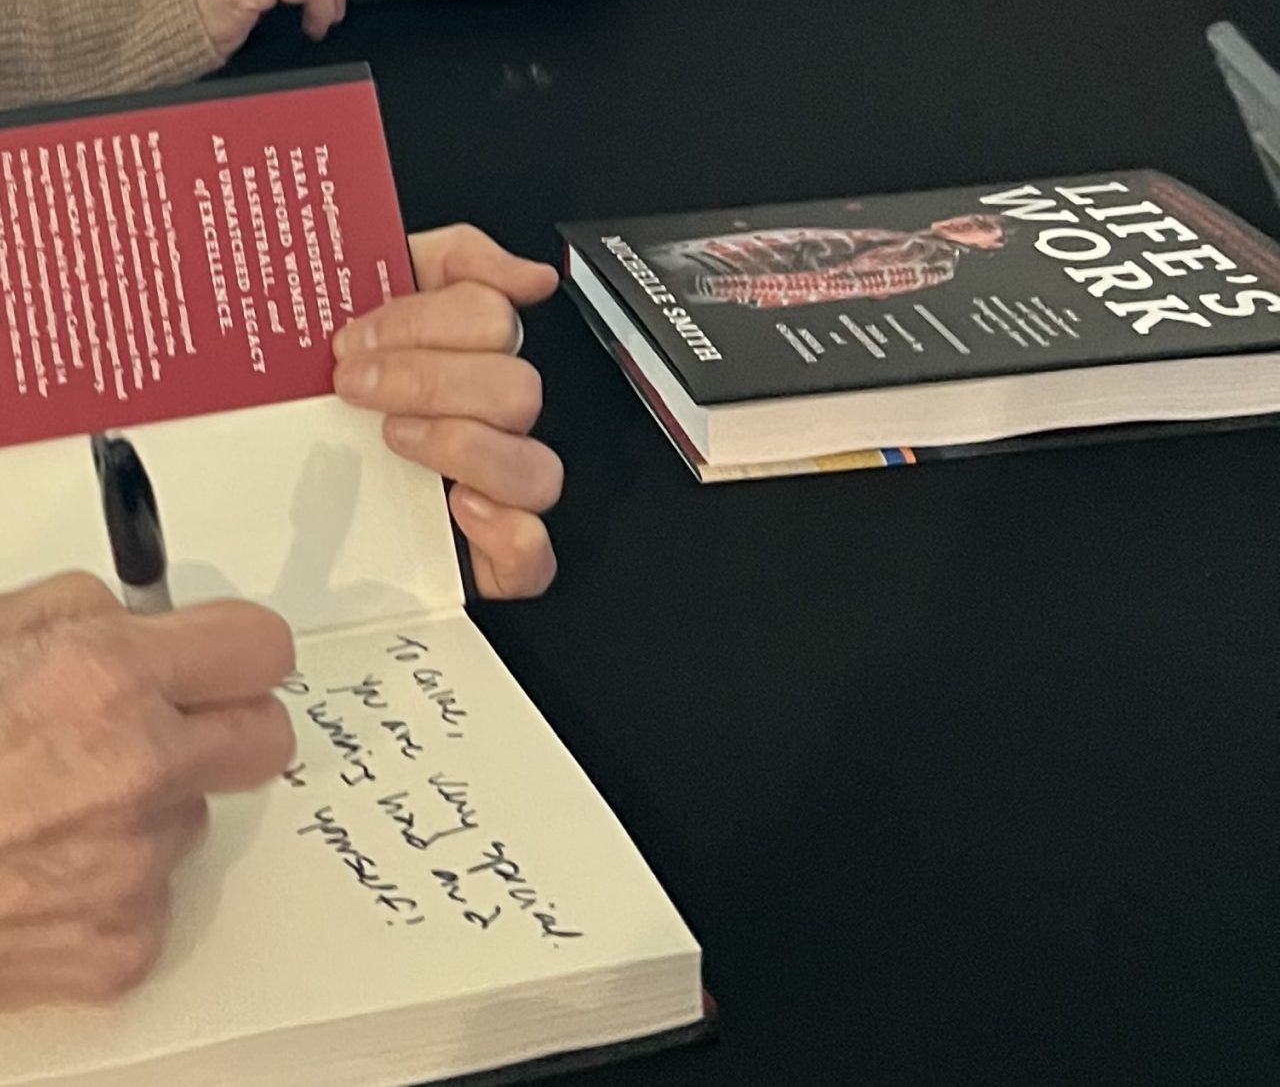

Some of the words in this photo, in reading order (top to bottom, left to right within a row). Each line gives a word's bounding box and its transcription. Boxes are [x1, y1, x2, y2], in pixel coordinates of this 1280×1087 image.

[211, 133, 228, 164] AN
[287, 146, 311, 199] TARA
[215, 168, 252, 292] UNMATCHED
[262, 145, 295, 248] STANFORD
[282, 253, 313, 348] WOMEN'S
[312, 143, 332, 176] The
[332, 266, 357, 312] Story
[979, 184, 1212, 334] WORK
[1054, 181, 1280, 317] LIFE'S
[239, 296, 266, 375] LEGACY
[266, 299, 285, 334] and
